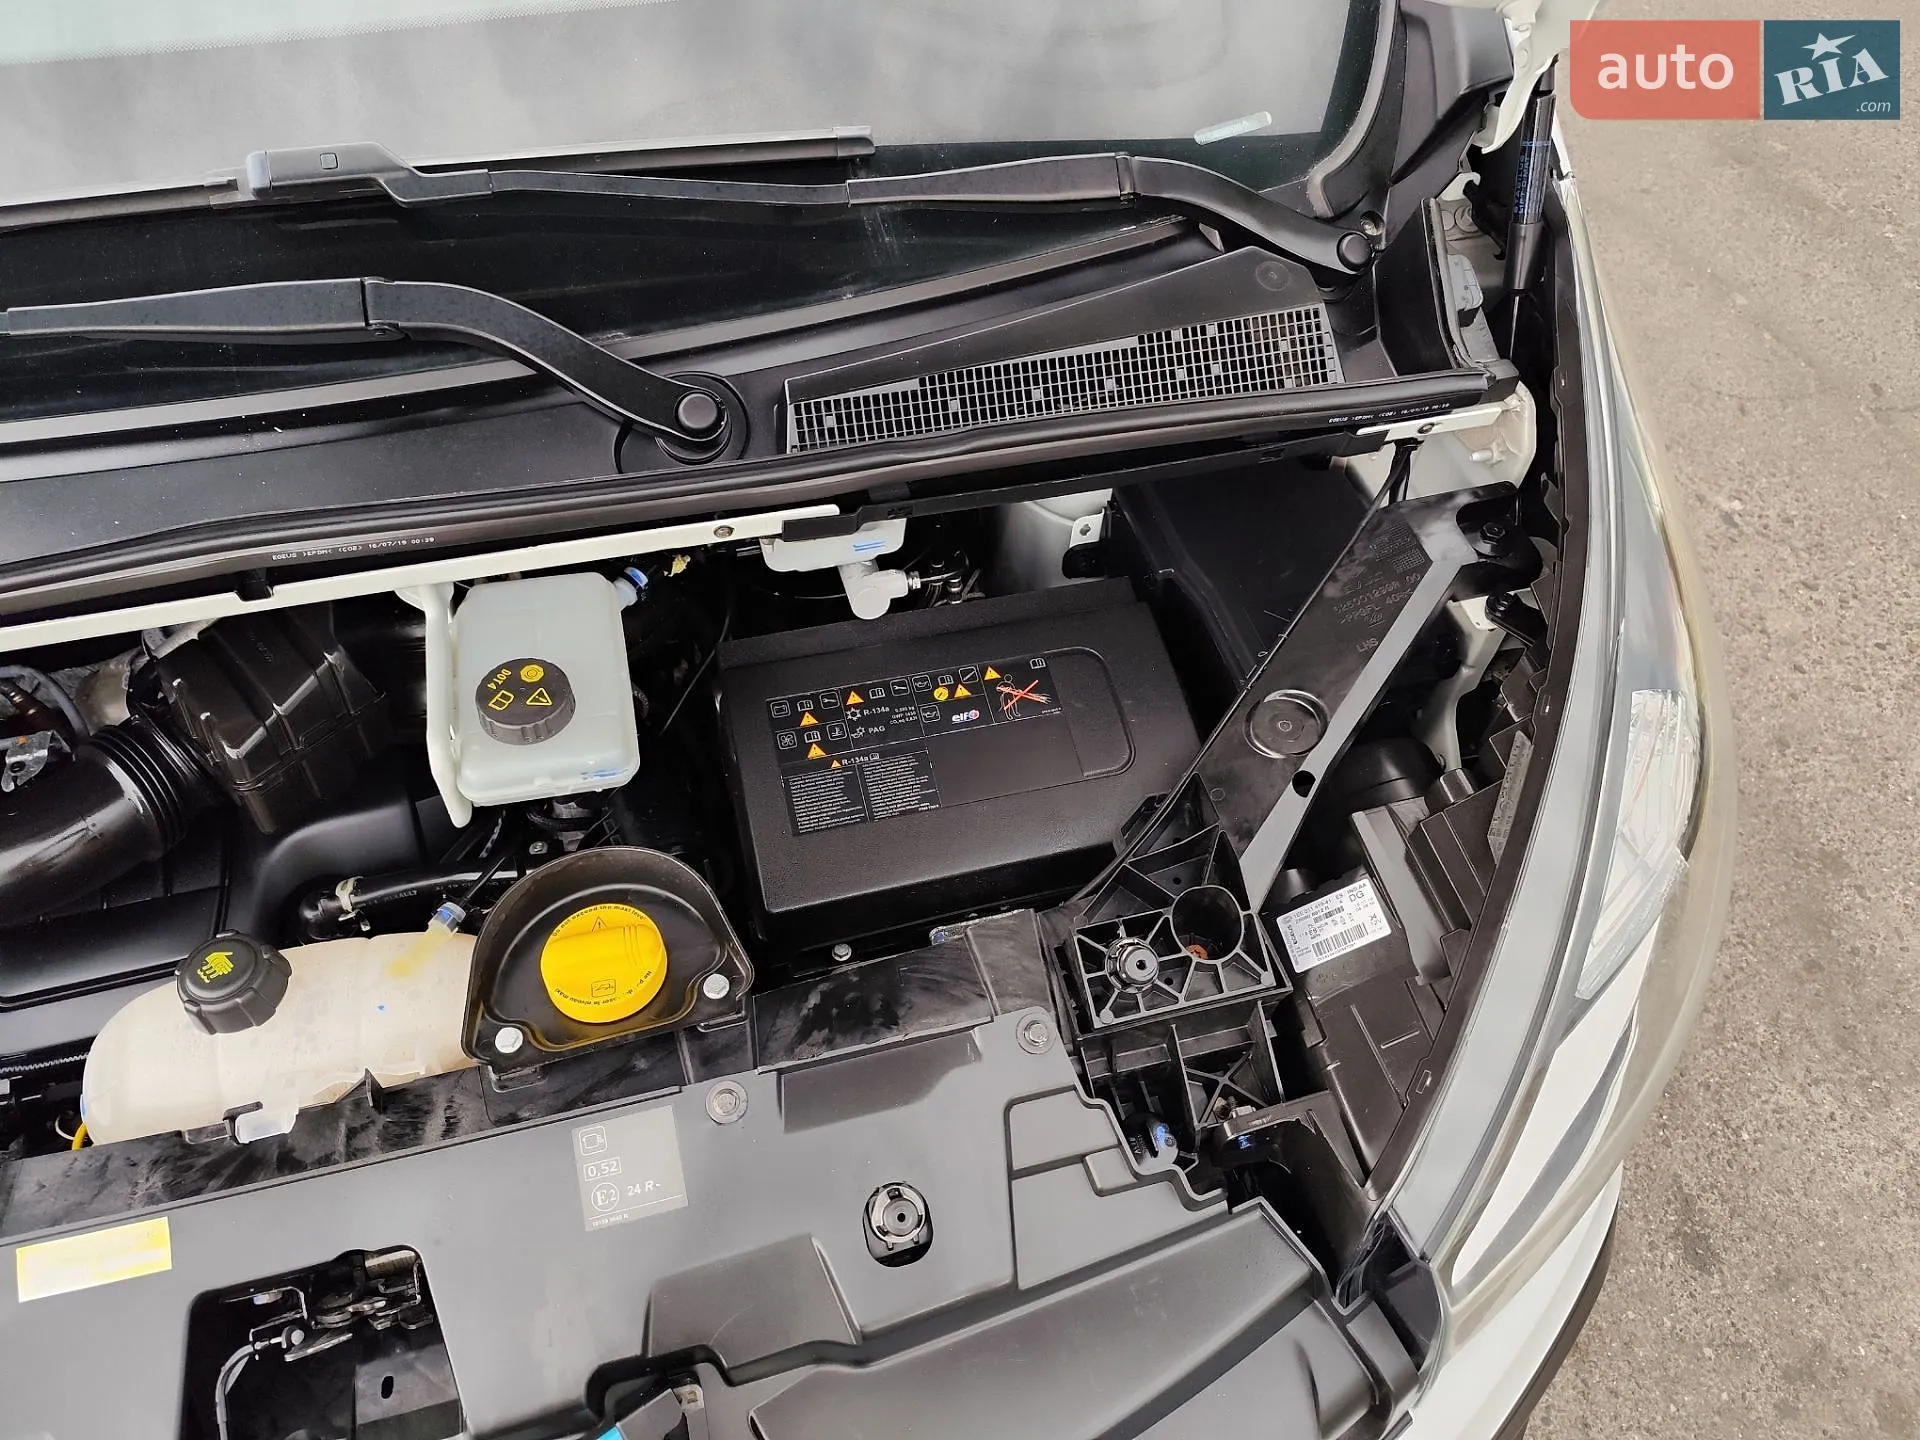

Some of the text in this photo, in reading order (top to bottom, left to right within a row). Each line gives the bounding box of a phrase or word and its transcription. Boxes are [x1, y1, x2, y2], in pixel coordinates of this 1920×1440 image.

[863, 706, 890, 716] R-134a
[868, 725, 886, 734] PAG
[841, 756, 869, 766] R-134a
[1349, 890, 1365, 902] DG
[588, 1161, 618, 1178] 0,52
[627, 1183, 642, 1196] 24
